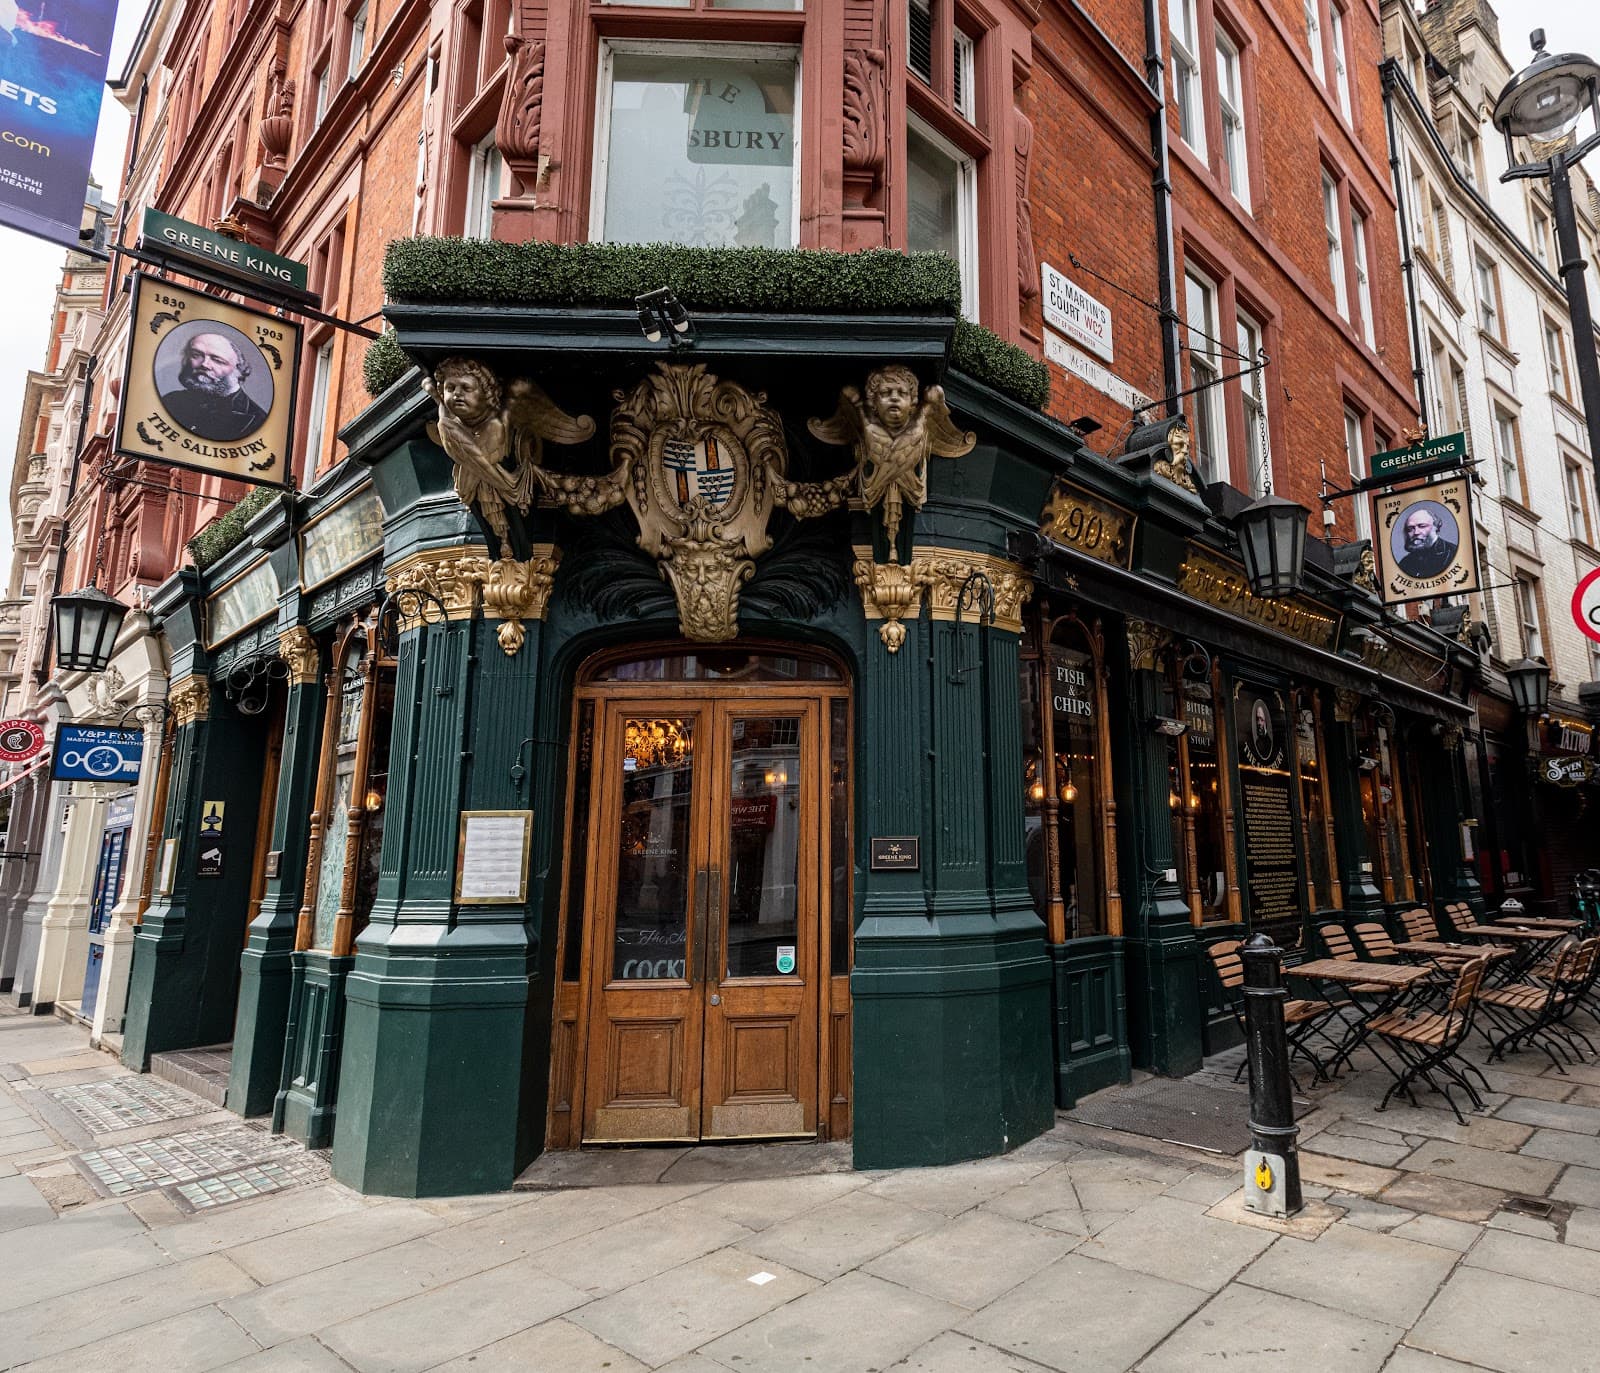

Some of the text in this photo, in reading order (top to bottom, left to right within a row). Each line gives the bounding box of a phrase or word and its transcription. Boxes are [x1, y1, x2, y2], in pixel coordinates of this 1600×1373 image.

[0, 79, 57, 115] ETS
[163, 227, 293, 282] GREENE KING
[154, 293, 186, 310] 1830
[1049, 273, 1106, 324] ST. MARTIN'S
[1050, 291, 1104, 339] COURT WC2
[255, 325, 283, 342] 1903
[147, 412, 268, 459] THE SALISBURY
[1380, 442, 1455, 469] GREENE KING
[1440, 487, 1458, 496] 1903
[1384, 500, 1401, 509] 1830
[1064, 507, 1102, 549] 90
[1394, 562, 1463, 590] THE SALISBURY
[1056, 666, 1085, 687] FISH
[1068, 685, 1076, 697] &
[1054, 696, 1092, 716] CHIPS
[66, 736, 144, 746] MASTER LOCKSMITHS
[77, 729, 136, 741] V&P FOX
[1190, 734, 1211, 747] STOUT
